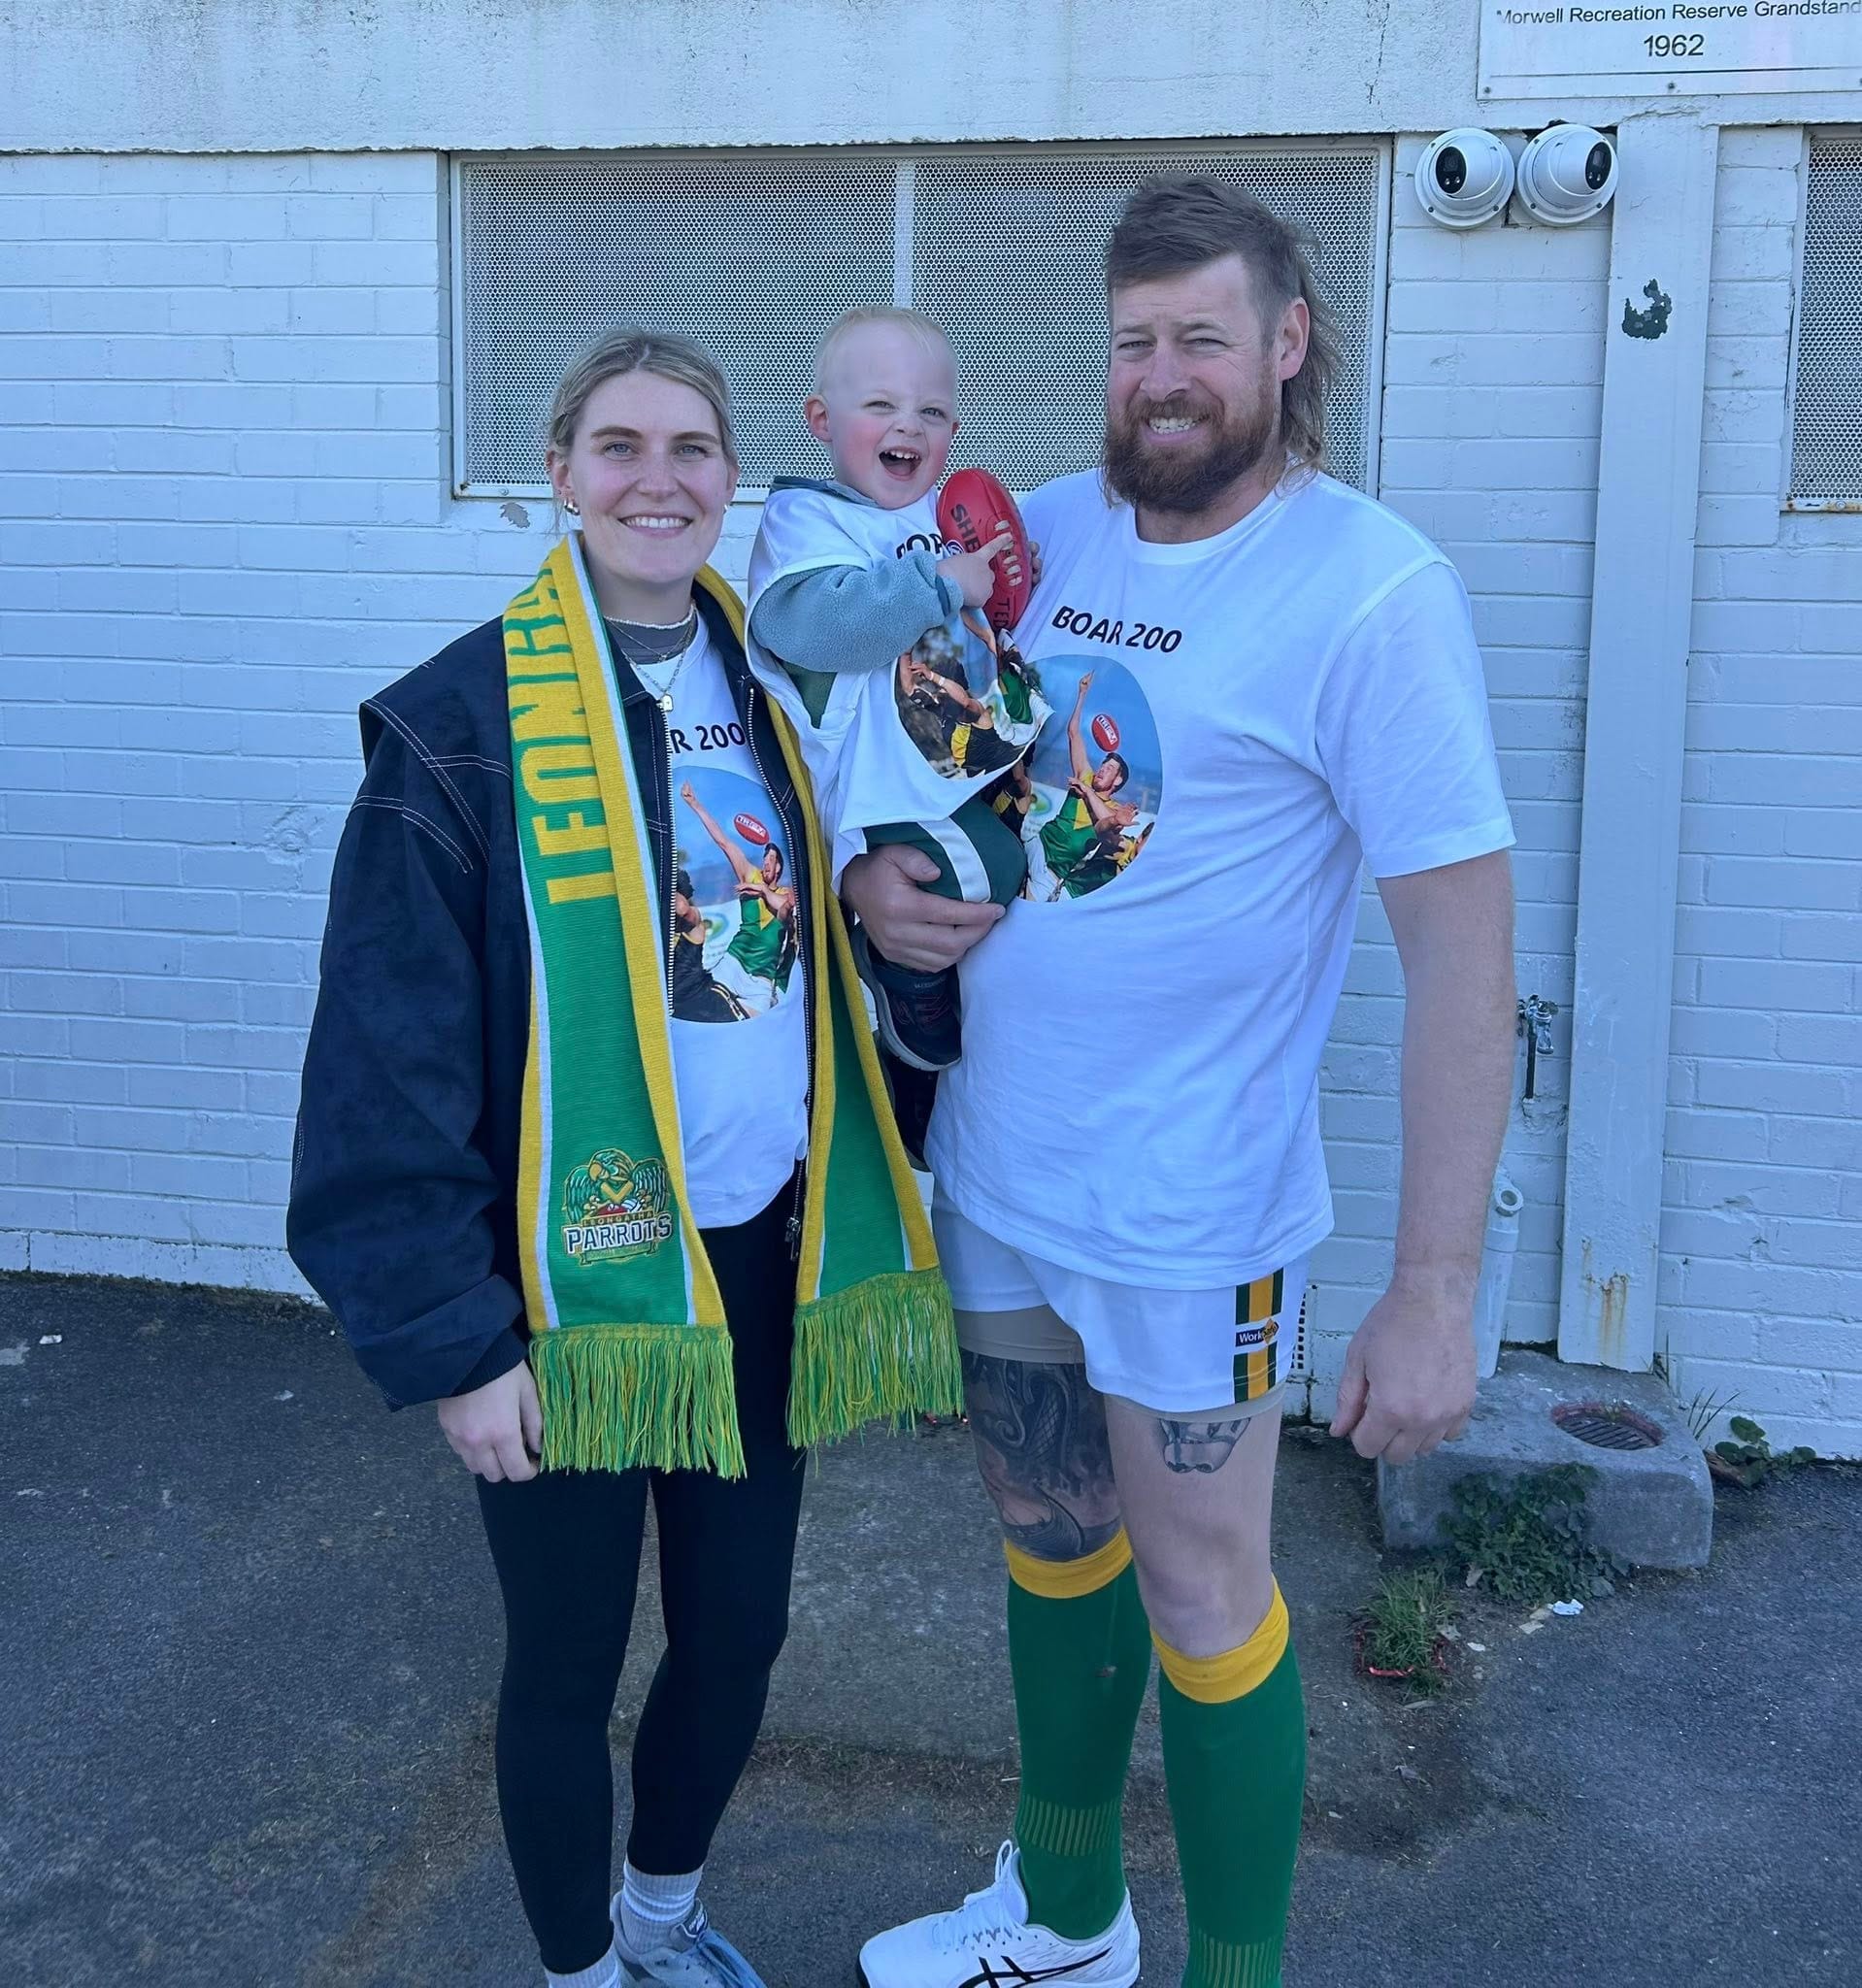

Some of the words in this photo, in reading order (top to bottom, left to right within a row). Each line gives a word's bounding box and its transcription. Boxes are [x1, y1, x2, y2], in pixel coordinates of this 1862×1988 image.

[1496, 8, 1564, 24] Morwell
[1570, 5, 1666, 22] Recreation
[1672, 4, 1747, 19] Reserve
[1754, 0, 1862, 17] Grandstand
[1644, 34, 1705, 57] 1962
[1051, 605, 1124, 646] BOAR
[1124, 622, 1182, 653] 200
[694, 722, 747, 750] 200
[564, 1212, 672, 1254] PARROTS
